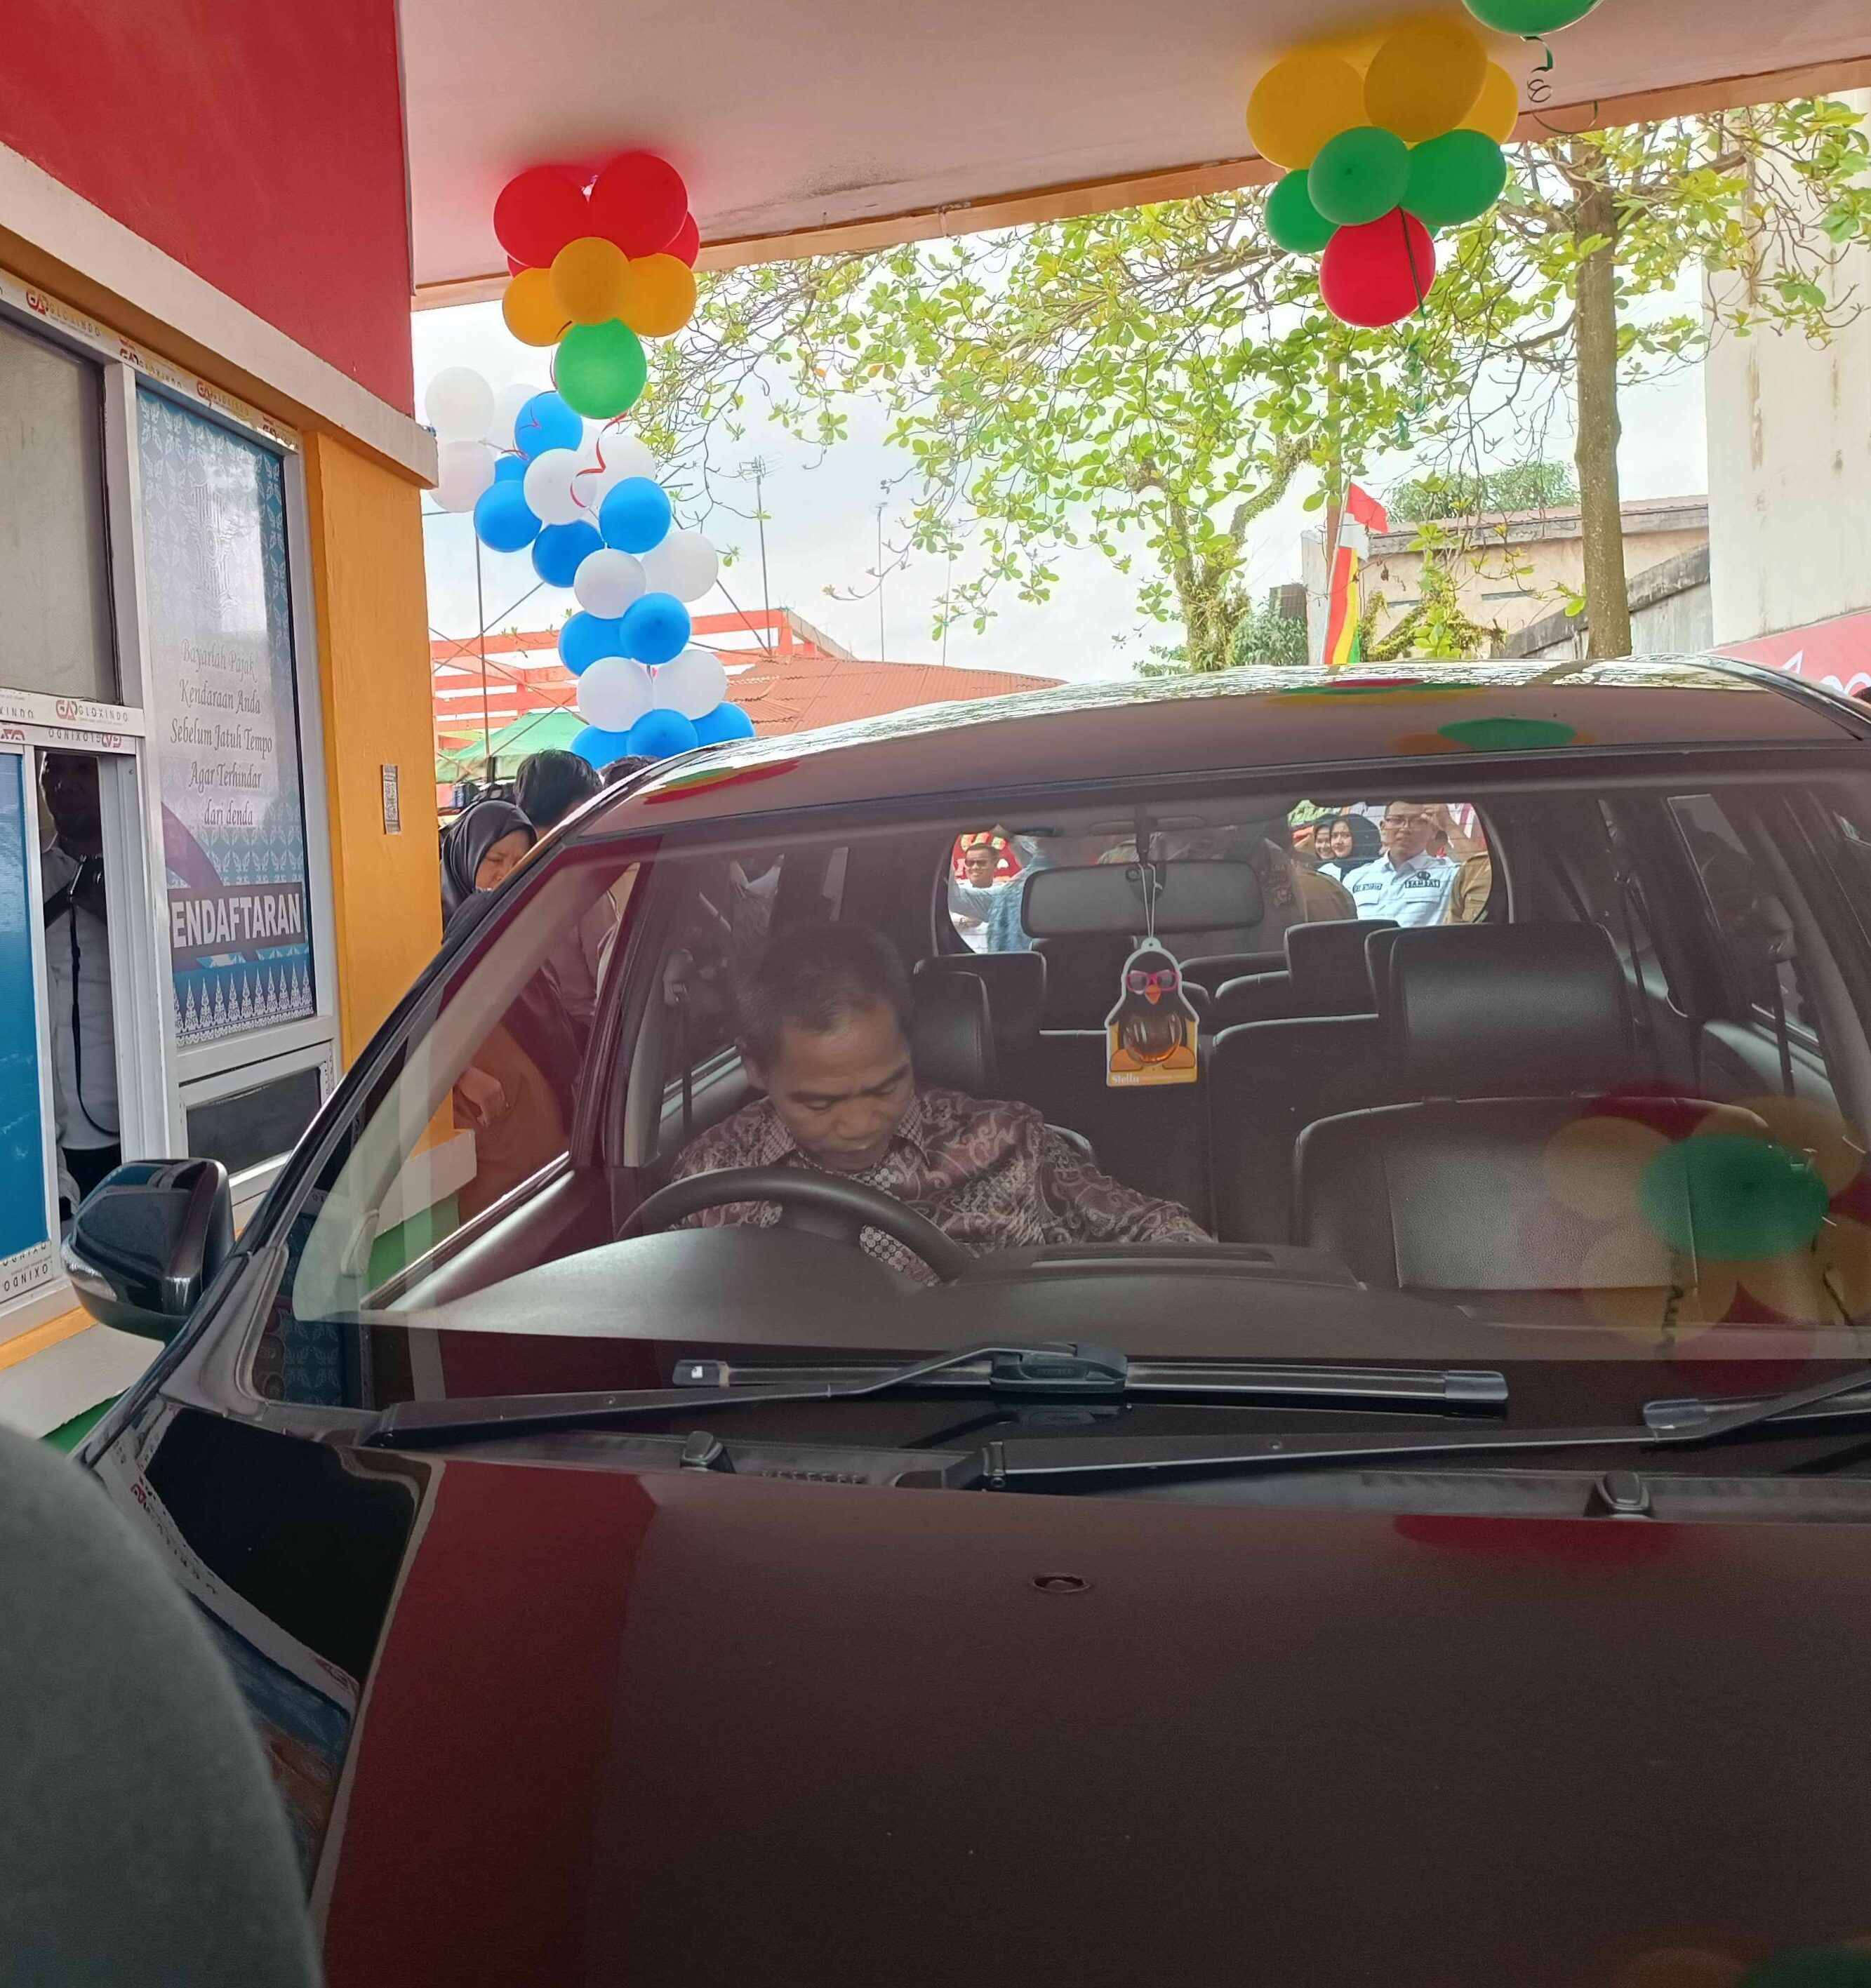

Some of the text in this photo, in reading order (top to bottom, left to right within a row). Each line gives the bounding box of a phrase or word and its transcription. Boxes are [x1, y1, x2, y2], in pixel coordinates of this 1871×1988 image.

[181, 639, 258, 683] Bayarlah Pajak
[78, 705, 128, 722] GLOXINDO
[180, 679, 261, 714] Kendaraan Anda
[170, 716, 273, 759] Sebelum Jatuh Tempo
[188, 761, 262, 794] Agar Terhindar
[204, 799, 253, 827] dari denda
[171, 893, 302, 948] ENDAFTARAN
